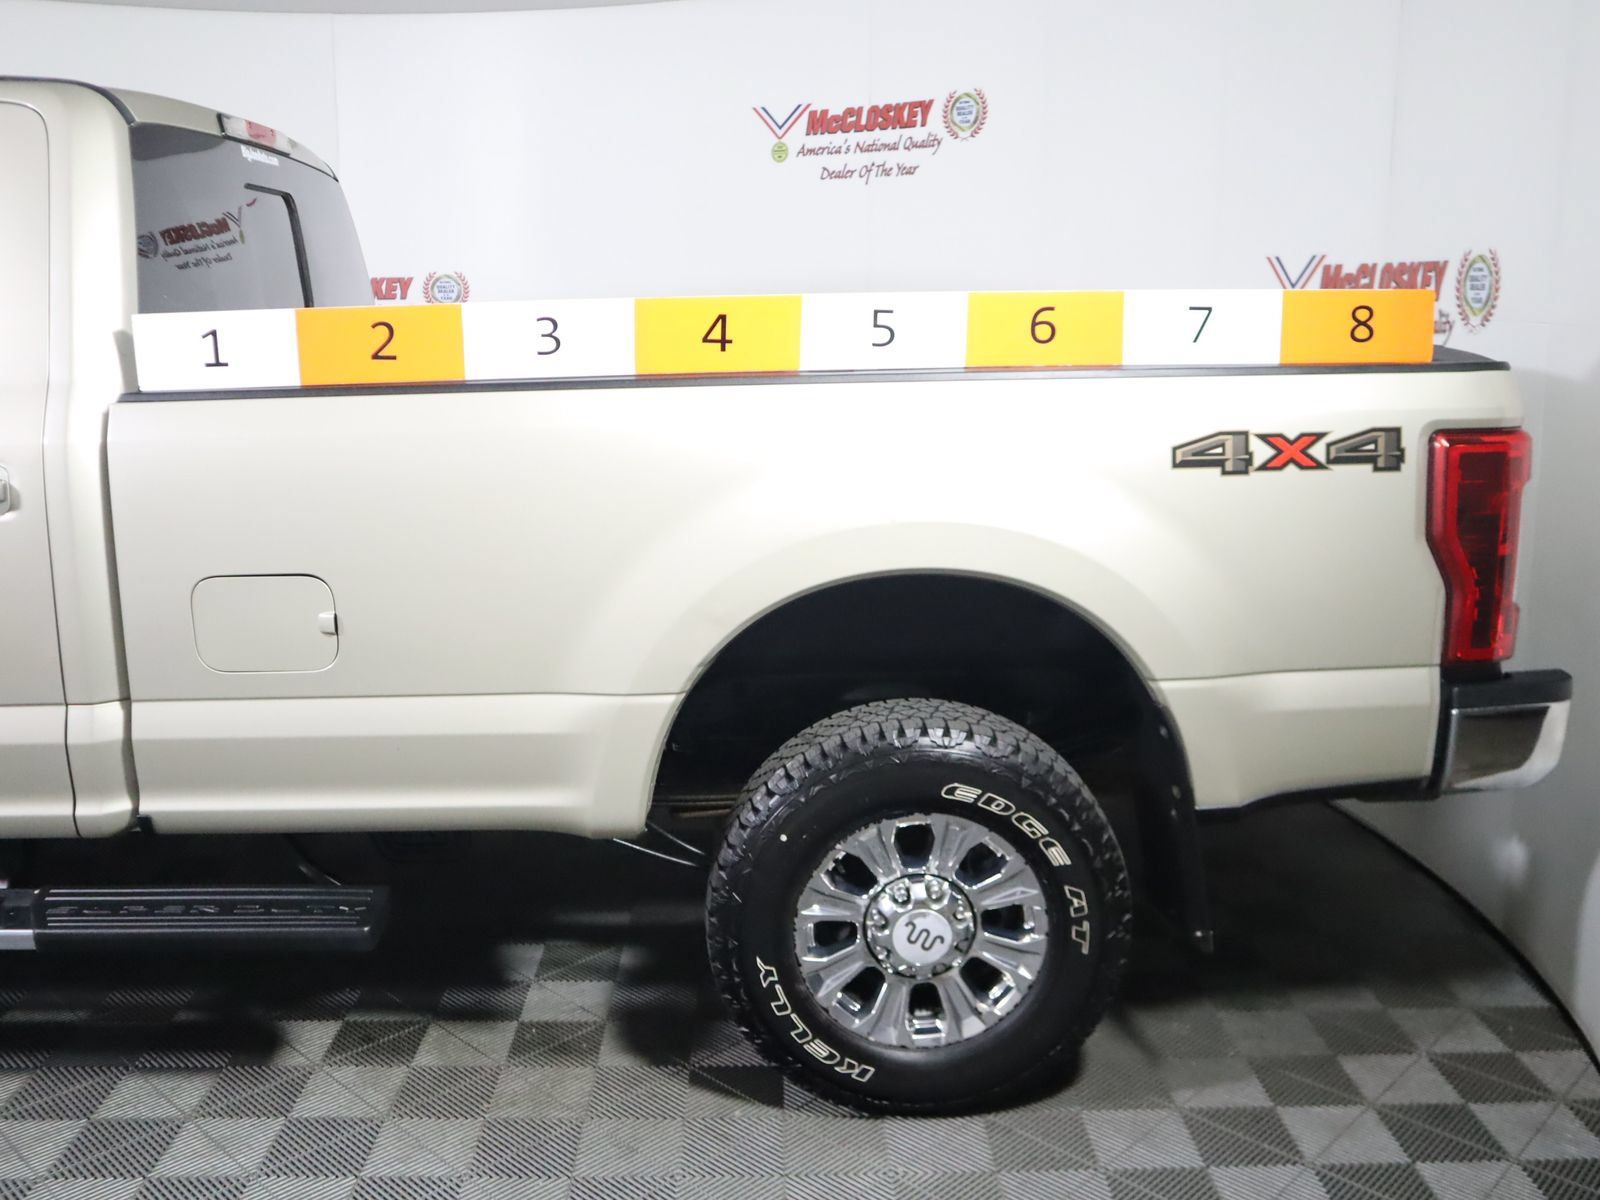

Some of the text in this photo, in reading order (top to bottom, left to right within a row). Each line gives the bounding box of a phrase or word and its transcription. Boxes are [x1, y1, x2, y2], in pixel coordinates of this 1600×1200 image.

[805, 98, 935, 136] McCLOSKEY
[796, 138, 851, 157] America's
[854, 134, 903, 154] National
[903, 131, 943, 156] Quality
[820, 161, 920, 185] Dealer Of The Year
[203, 305, 1374, 367] 1 2 3 4 5 6 7 8
[940, 782, 1091, 955] EDGE AT
[756, 956, 876, 1083] KELLY
